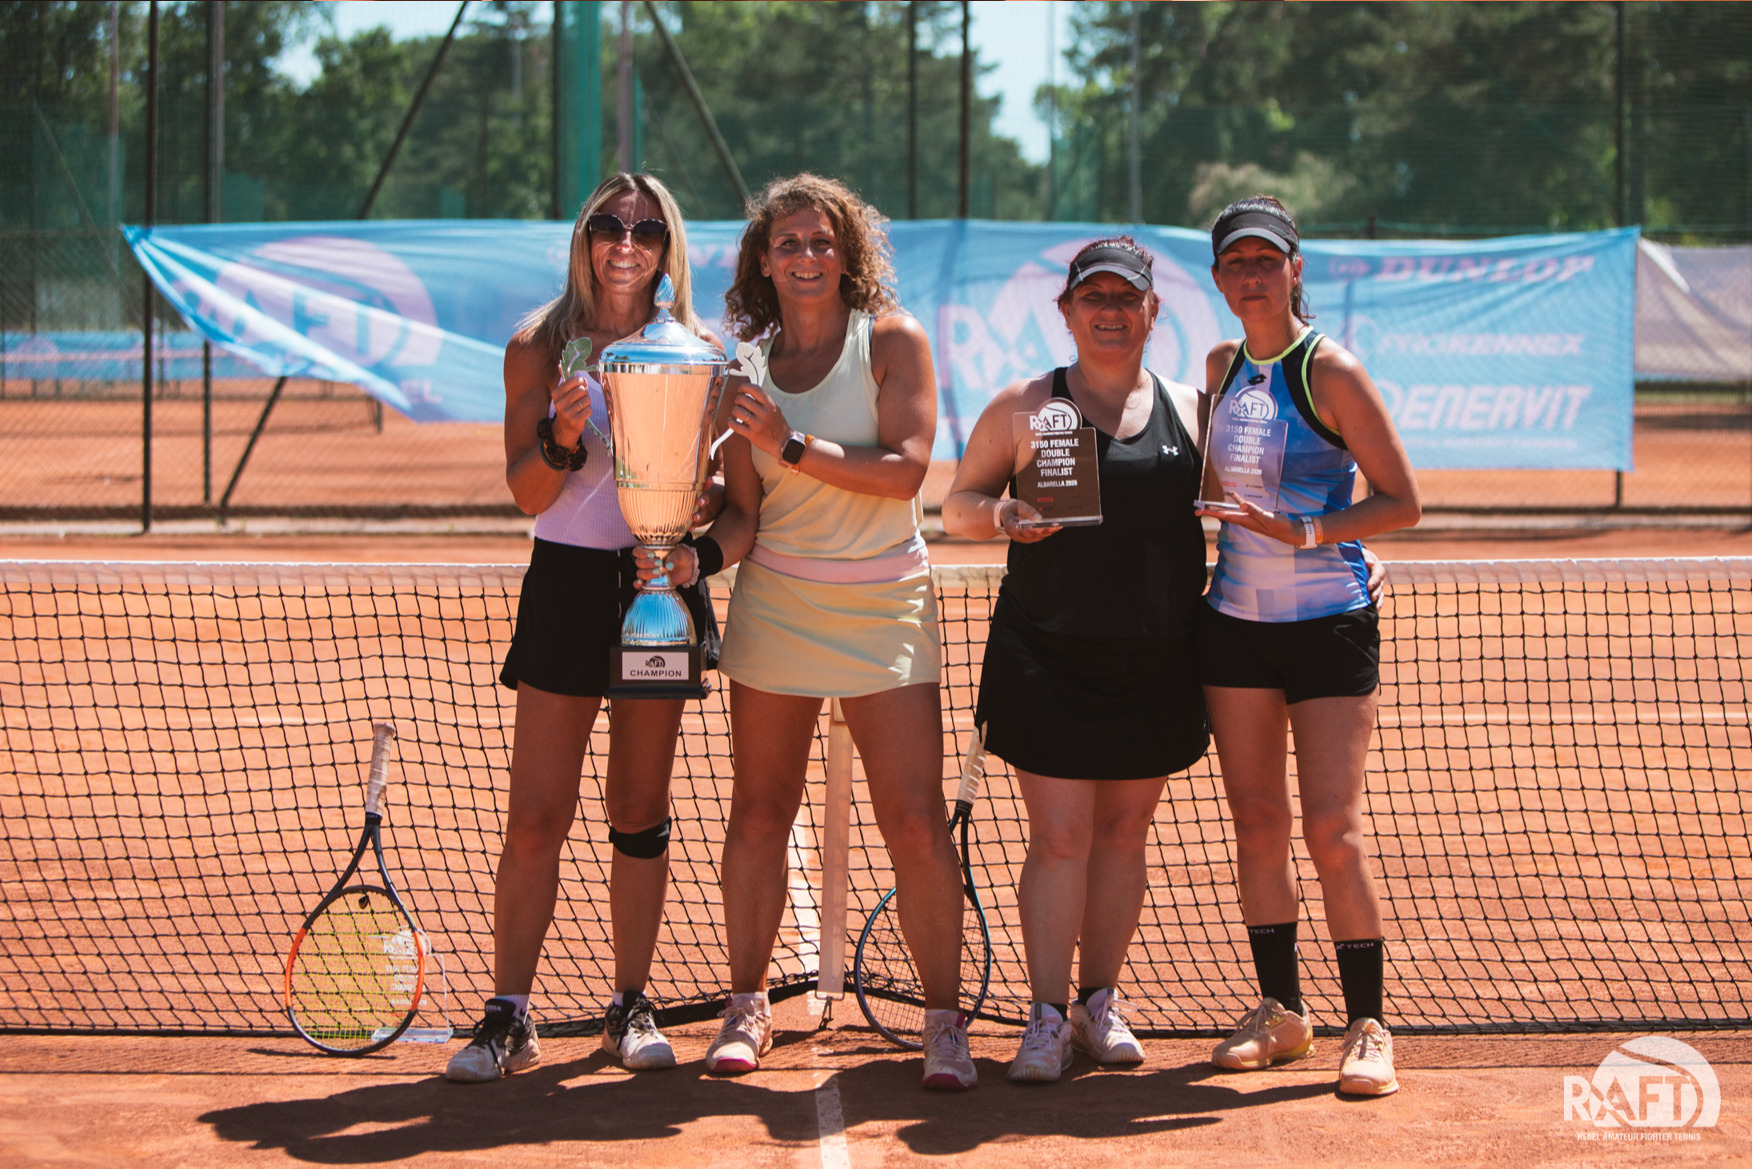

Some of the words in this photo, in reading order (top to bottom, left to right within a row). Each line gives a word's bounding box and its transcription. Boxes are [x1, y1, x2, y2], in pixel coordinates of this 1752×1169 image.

[1375, 256, 1595, 283] DUNLOP
[1229, 399, 1267, 417] RAFT
[1400, 385, 1593, 430] ENERVIT
[1029, 414, 1069, 430] RAFT
[1244, 426, 1271, 437] FEMALE
[1031, 440, 1048, 449] 3150
[1050, 438, 1079, 448] FEMALE
[1233, 435, 1261, 445] DOUBLE
[1041, 449, 1070, 458] DOUBLE
[1227, 444, 1265, 455] CHAMPION
[1037, 458, 1075, 468] CHAMPION
[1229, 453, 1261, 464] FINALIST
[1040, 467, 1073, 477] FINALIST
[630, 669, 682, 677] CHAMPION
